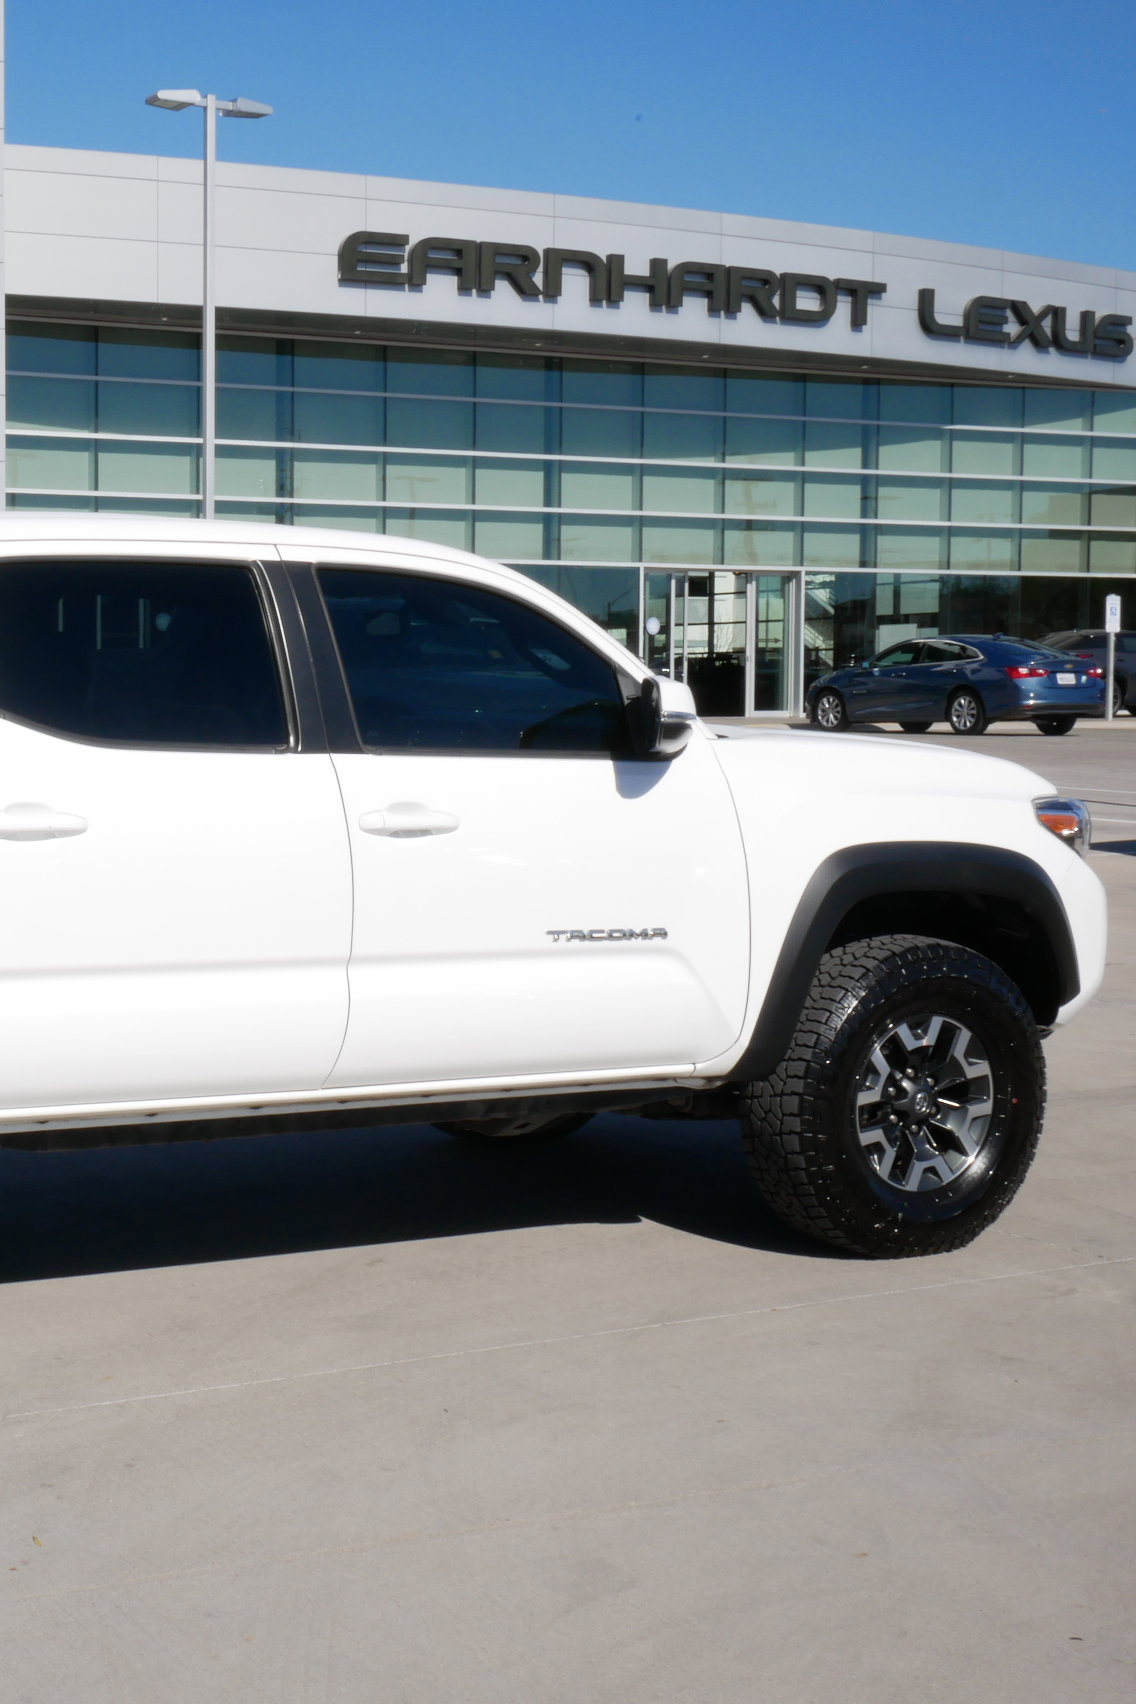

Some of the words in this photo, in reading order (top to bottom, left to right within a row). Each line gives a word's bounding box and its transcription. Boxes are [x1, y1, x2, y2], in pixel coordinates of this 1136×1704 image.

[337, 230, 887, 329] EARNHARDT
[918, 288, 1134, 358] LEXUS
[545, 927, 669, 942] TACOMA
